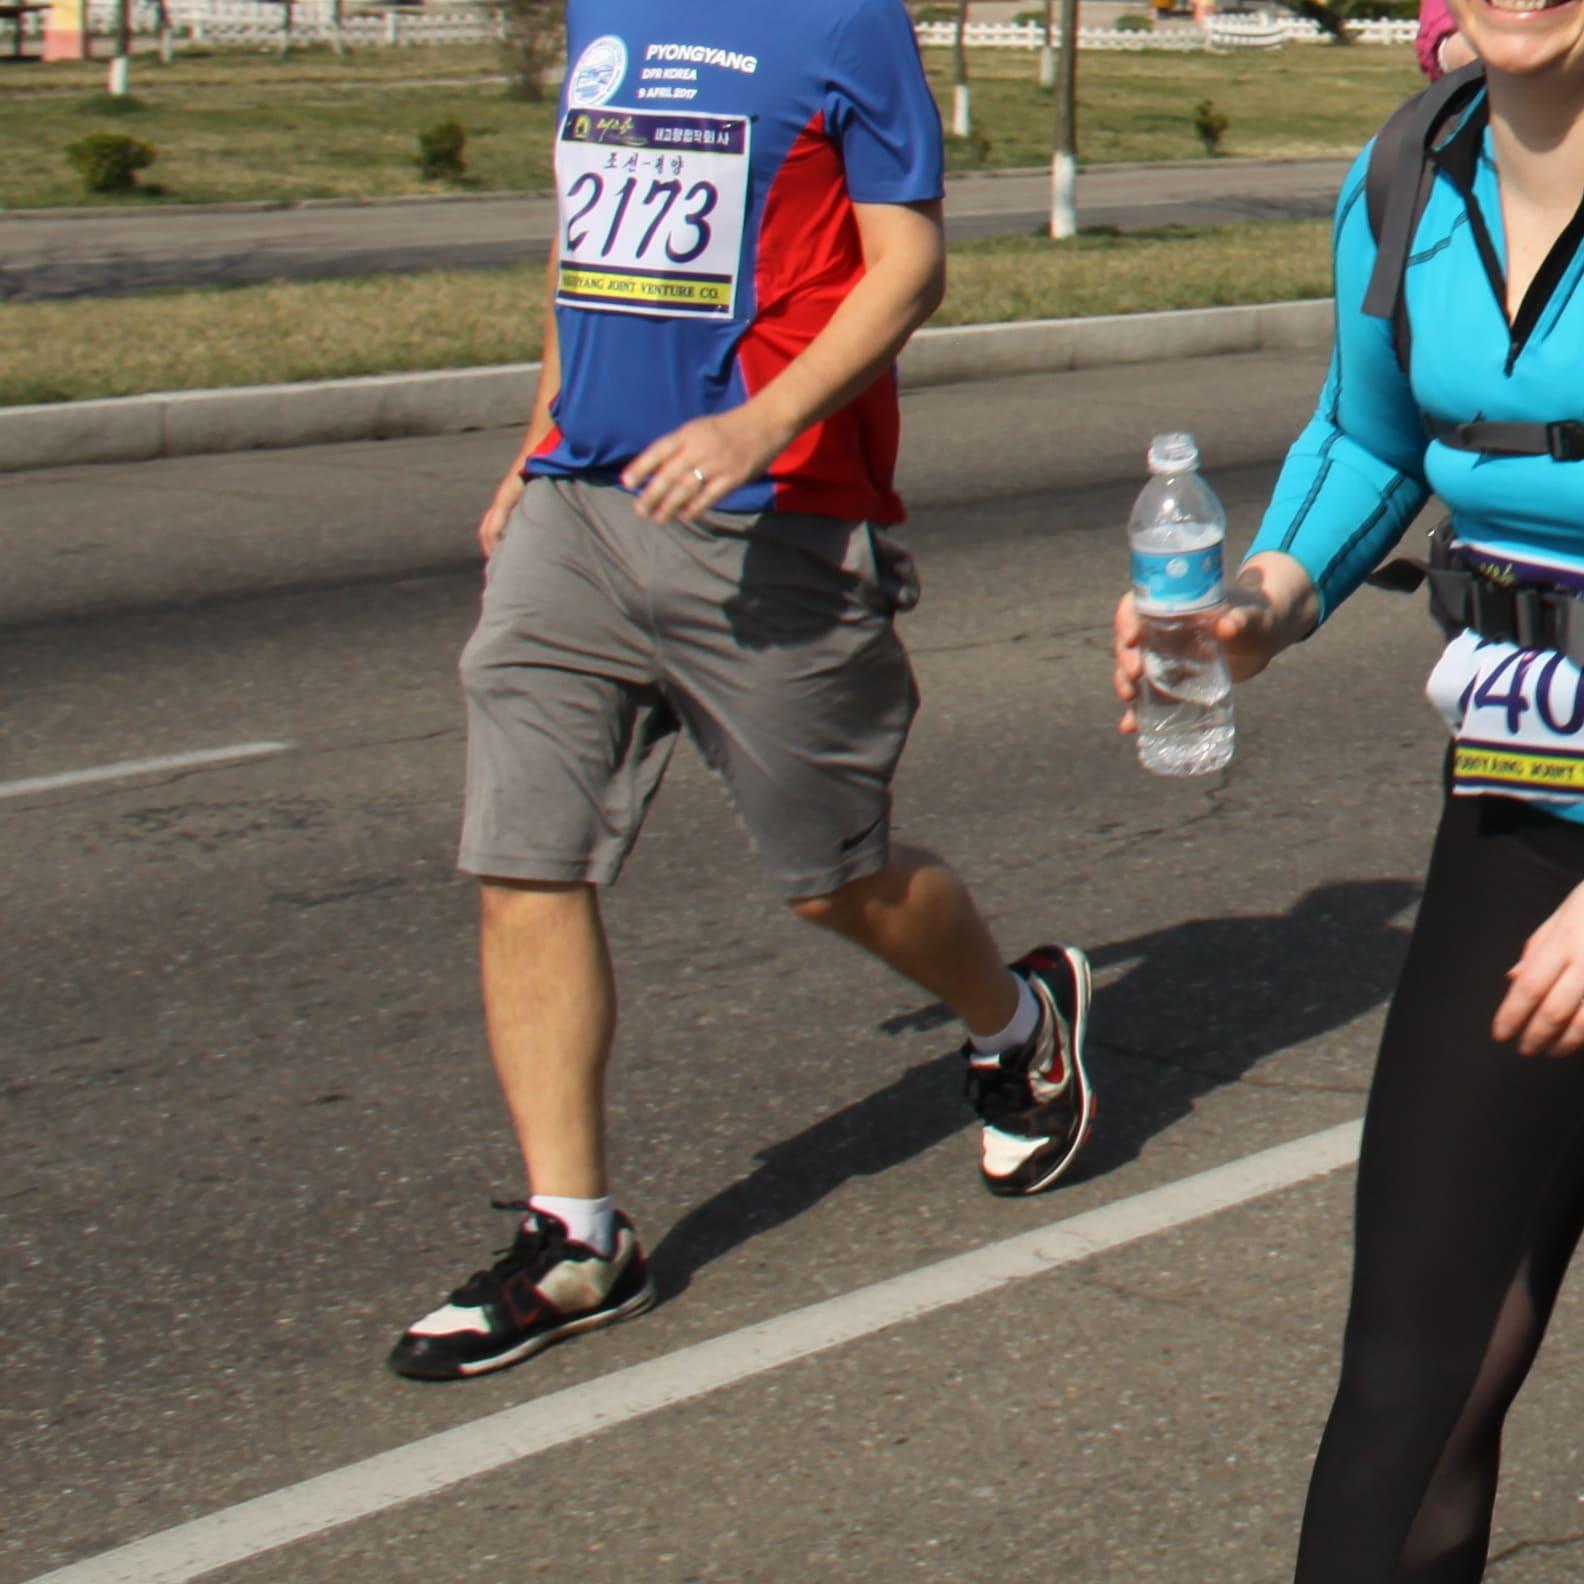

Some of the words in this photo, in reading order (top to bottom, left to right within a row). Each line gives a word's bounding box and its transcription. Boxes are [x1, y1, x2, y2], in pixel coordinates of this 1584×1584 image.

[645, 44, 758, 73] PYONGYANG
[641, 68, 662, 80] DPR
[663, 68, 697, 81] KOREA
[637, 87, 646, 99] 9
[647, 87, 672, 99] APRIL
[673, 89, 698, 100] 2017
[565, 172, 719, 264] 2173
[607, 279, 636, 294] JOINT
[641, 282, 695, 298] VENTURE
